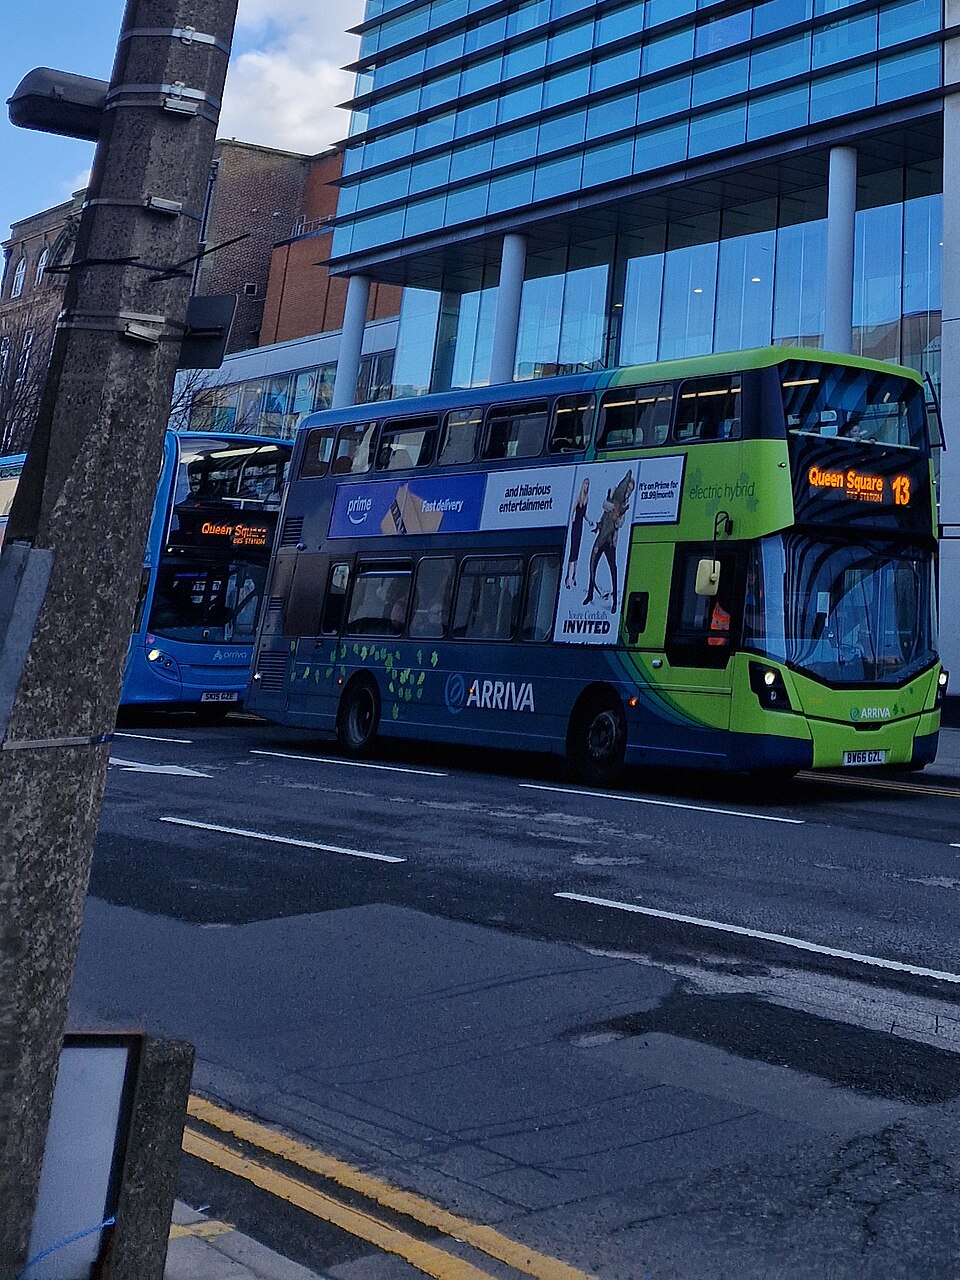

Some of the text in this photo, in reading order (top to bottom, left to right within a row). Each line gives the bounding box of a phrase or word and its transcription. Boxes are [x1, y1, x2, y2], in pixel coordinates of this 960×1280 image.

[505, 483, 551, 498] and hilarious
[655, 481, 670, 490] Prime
[670, 480, 679, 489] for
[689, 481, 755, 501] electric hybrid
[808, 466, 910, 505] Queen Square 13
[347, 496, 372, 515] prime
[421, 498, 463, 512] Fast delivery
[499, 498, 553, 513] entertainment
[202, 523, 232, 535] Queen
[563, 620, 611, 634] INVITED
[466, 679, 535, 712] ARRIVA
[861, 707, 891, 718] ARRIVA
